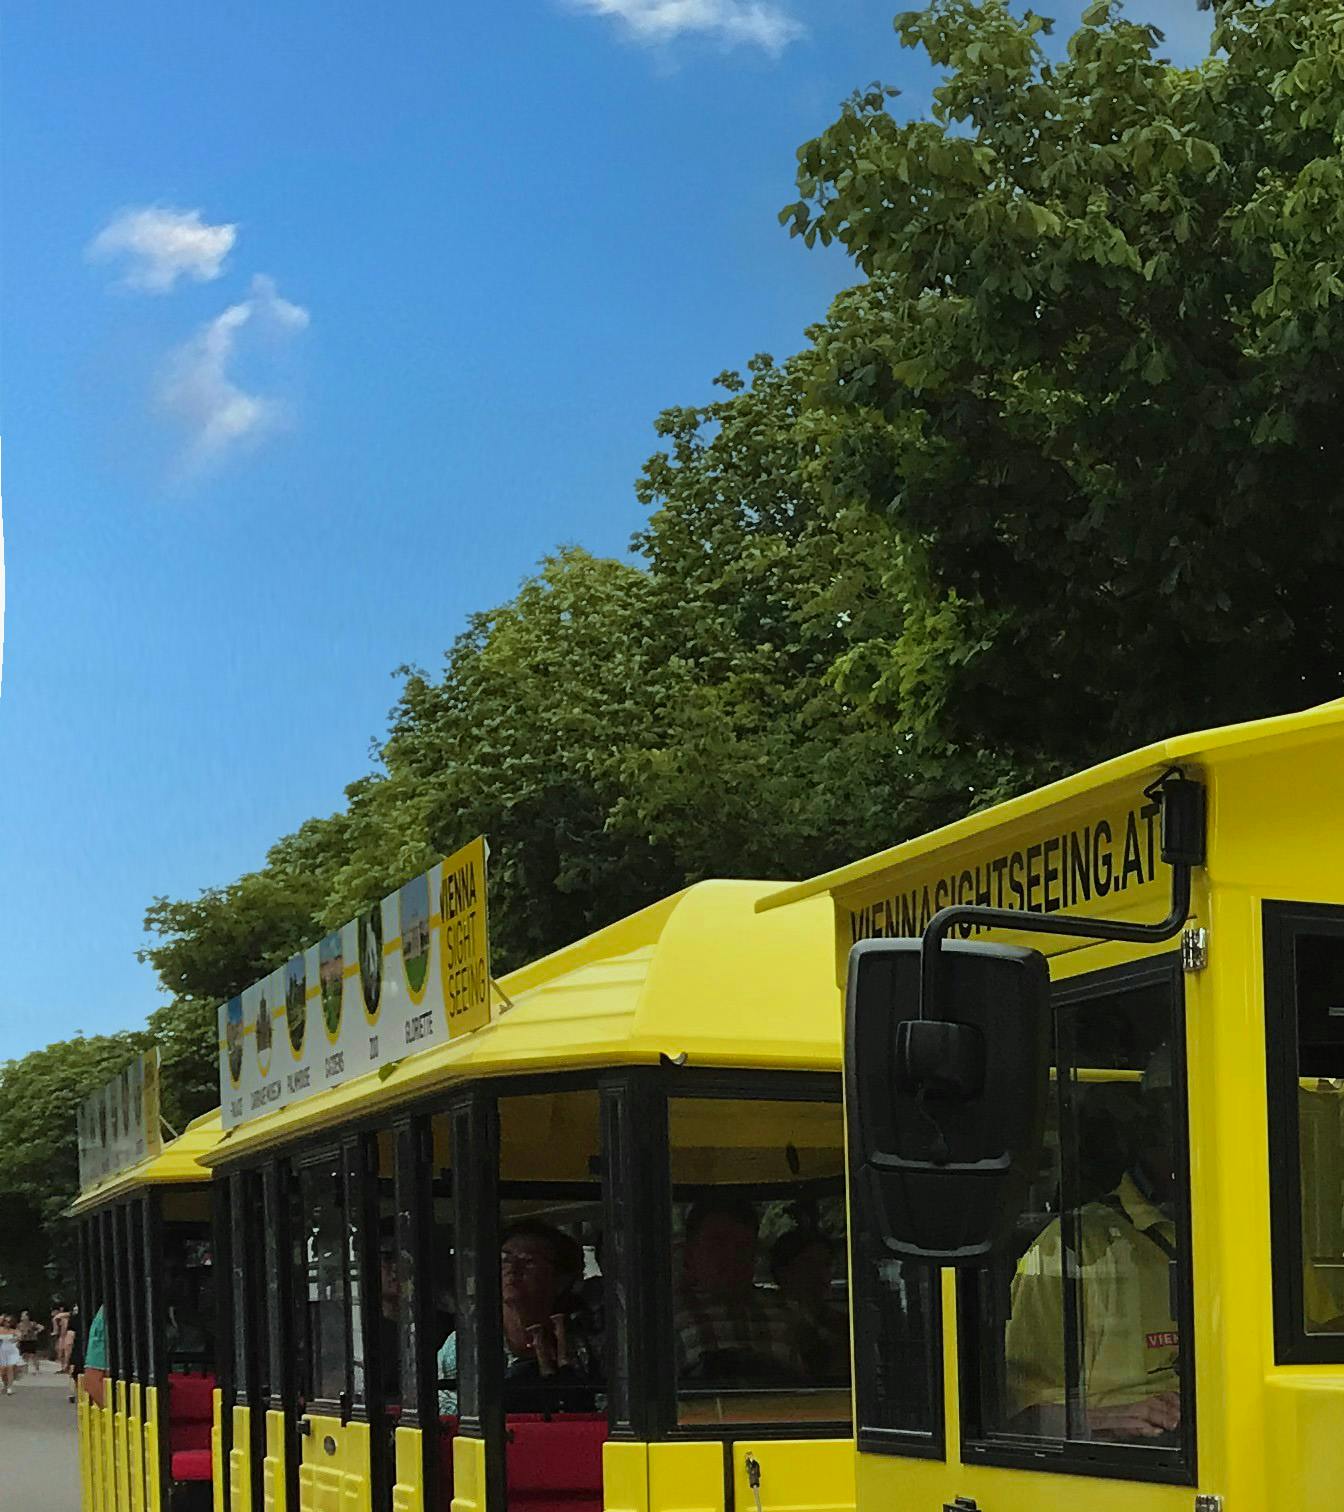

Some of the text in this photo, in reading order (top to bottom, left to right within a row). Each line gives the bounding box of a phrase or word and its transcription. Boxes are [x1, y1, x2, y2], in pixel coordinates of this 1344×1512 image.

[440, 861, 477, 923] VIENNA
[446, 911, 476, 970] SIGHT
[448, 957, 486, 1018] SEEING
